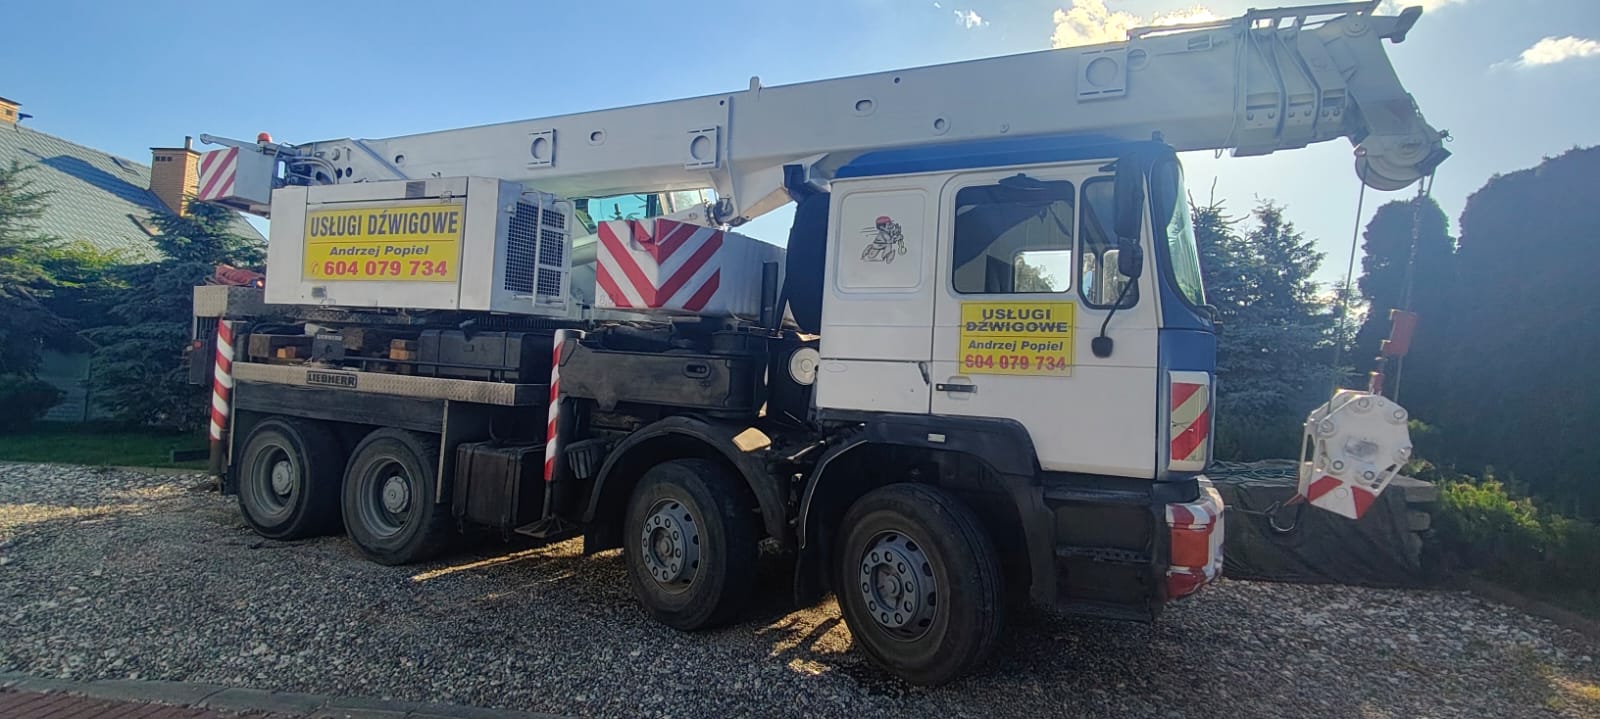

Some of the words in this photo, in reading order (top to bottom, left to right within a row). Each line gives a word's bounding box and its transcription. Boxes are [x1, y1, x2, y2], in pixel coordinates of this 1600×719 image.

[310, 215, 362, 237] USŁUGI
[368, 209, 459, 235] DŹWIGOWE
[329, 246, 381, 257] Andrzej
[384, 245, 429, 257] Popiel
[324, 260, 358, 276] 604
[365, 260, 401, 276] 079
[409, 260, 447, 276] 734
[982, 308, 1051, 320] USŁUGI
[966, 319, 1068, 333] DŹWIGOWE
[968, 340, 1017, 352] Andrzej
[1021, 340, 1063, 352] Popiel
[965, 354, 994, 368] 604
[999, 354, 1029, 370] 079
[1035, 355, 1066, 371] 734
[308, 373, 355, 386] LIEBHERR
